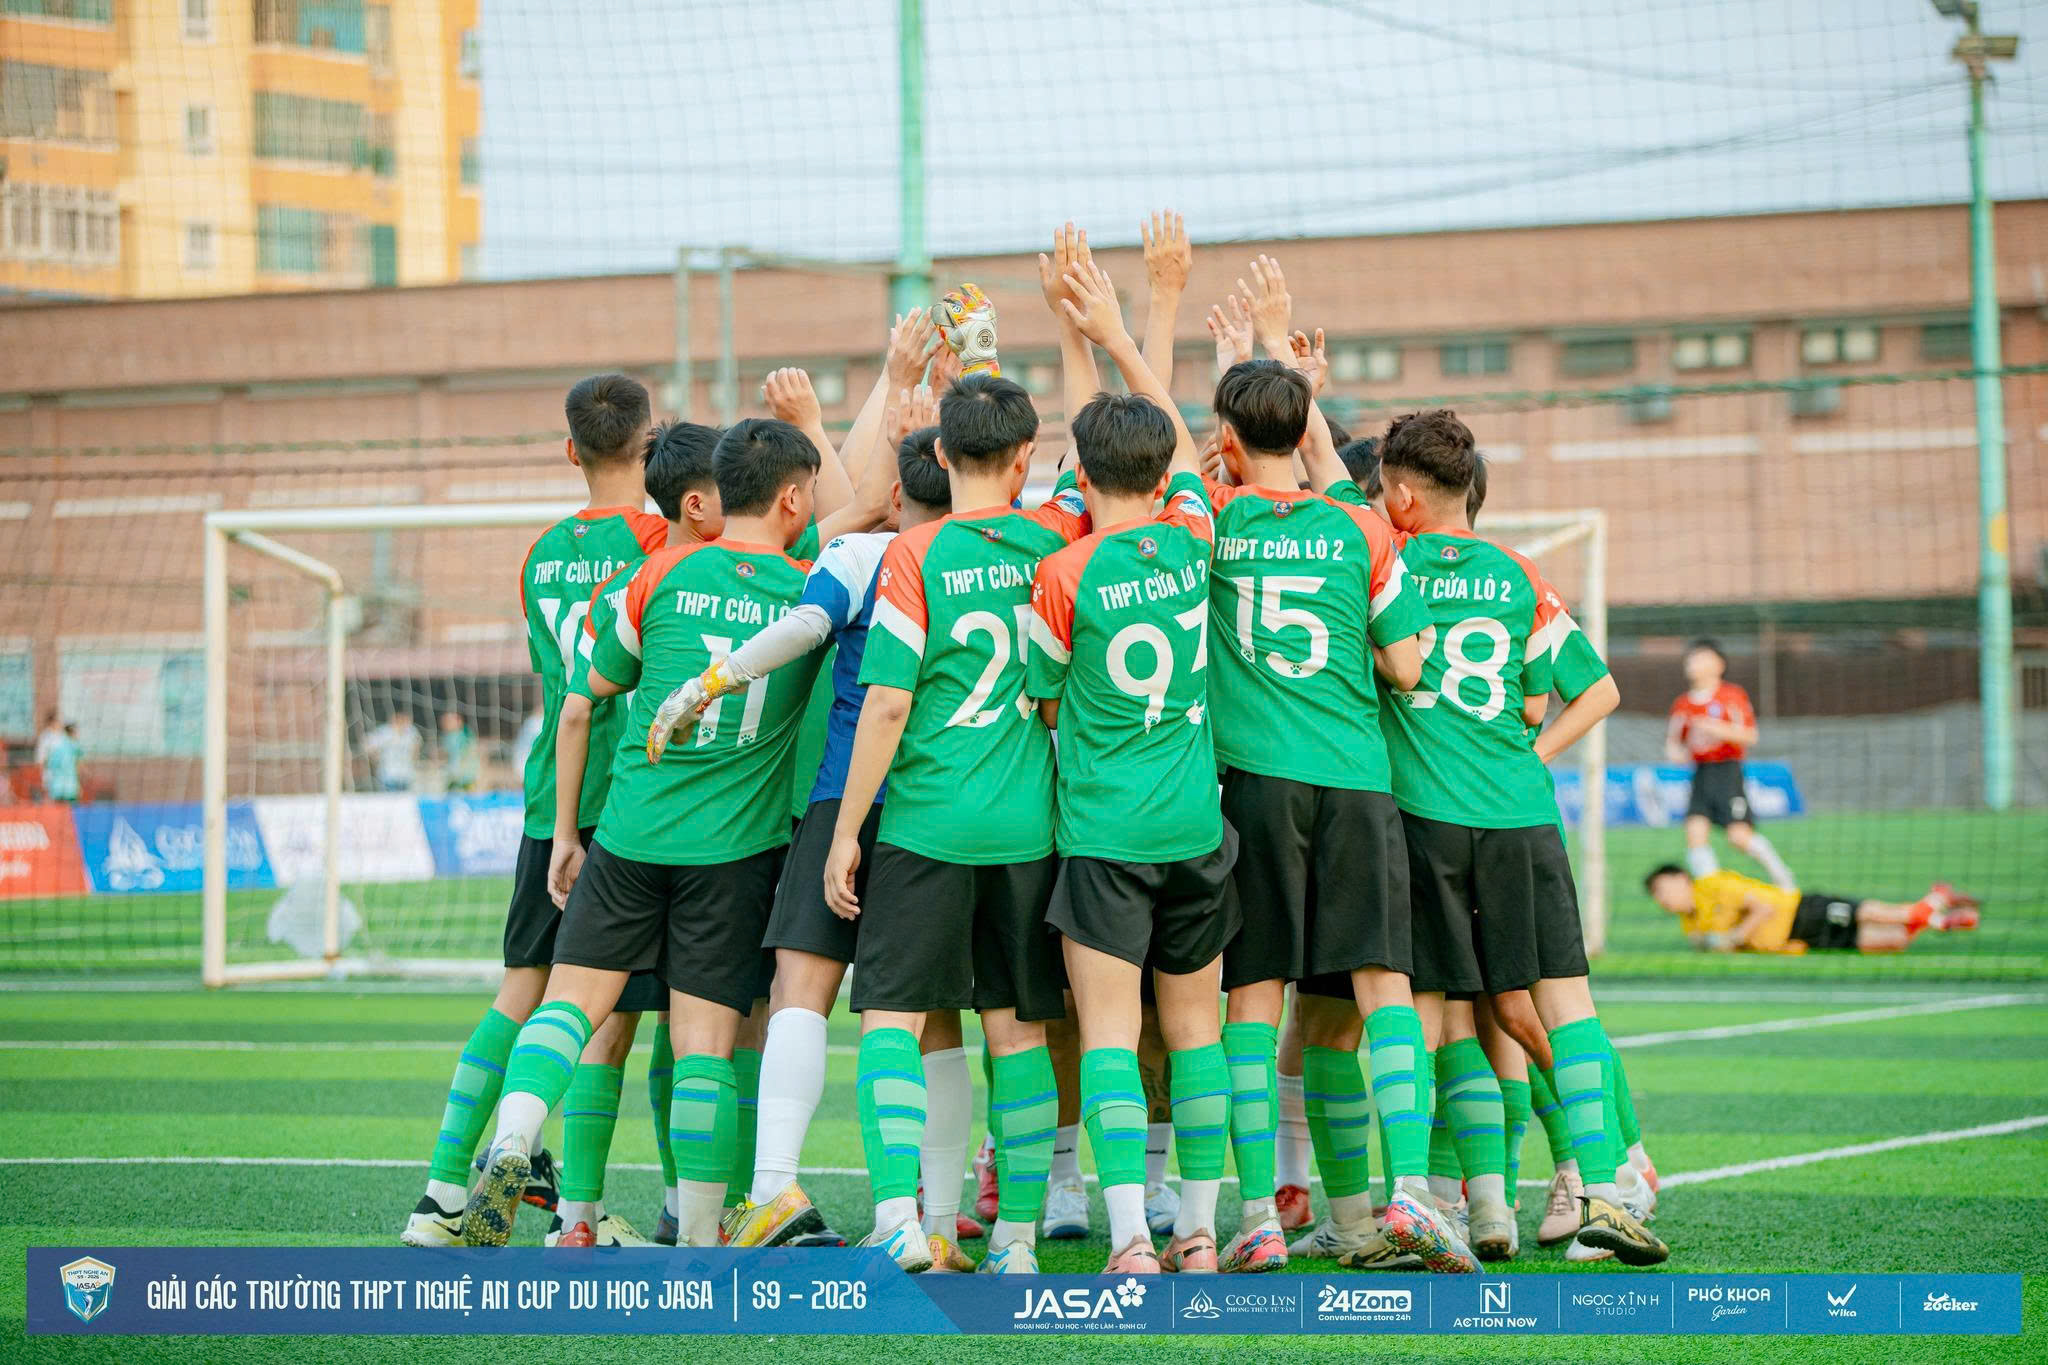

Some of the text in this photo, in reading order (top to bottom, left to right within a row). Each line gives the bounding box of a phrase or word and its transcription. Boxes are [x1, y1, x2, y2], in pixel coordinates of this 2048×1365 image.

[1216, 534, 1344, 561] THPT CỬA LÒ 2
[534, 560, 563, 584] THPT
[565, 553, 592, 584] CỬA
[941, 567, 984, 596] THPT
[1024, 556, 1040, 586] L
[1432, 571, 1468, 600] CỬA
[1473, 573, 1496, 601] LÒ
[1499, 580, 1512, 603] 2
[676, 590, 721, 619] THPT
[724, 594, 762, 625] CỬA
[1097, 580, 1143, 611] THPT
[1144, 568, 1180, 601] CỬA
[1230, 575, 1330, 679] 15
[695, 634, 769, 748] 11
